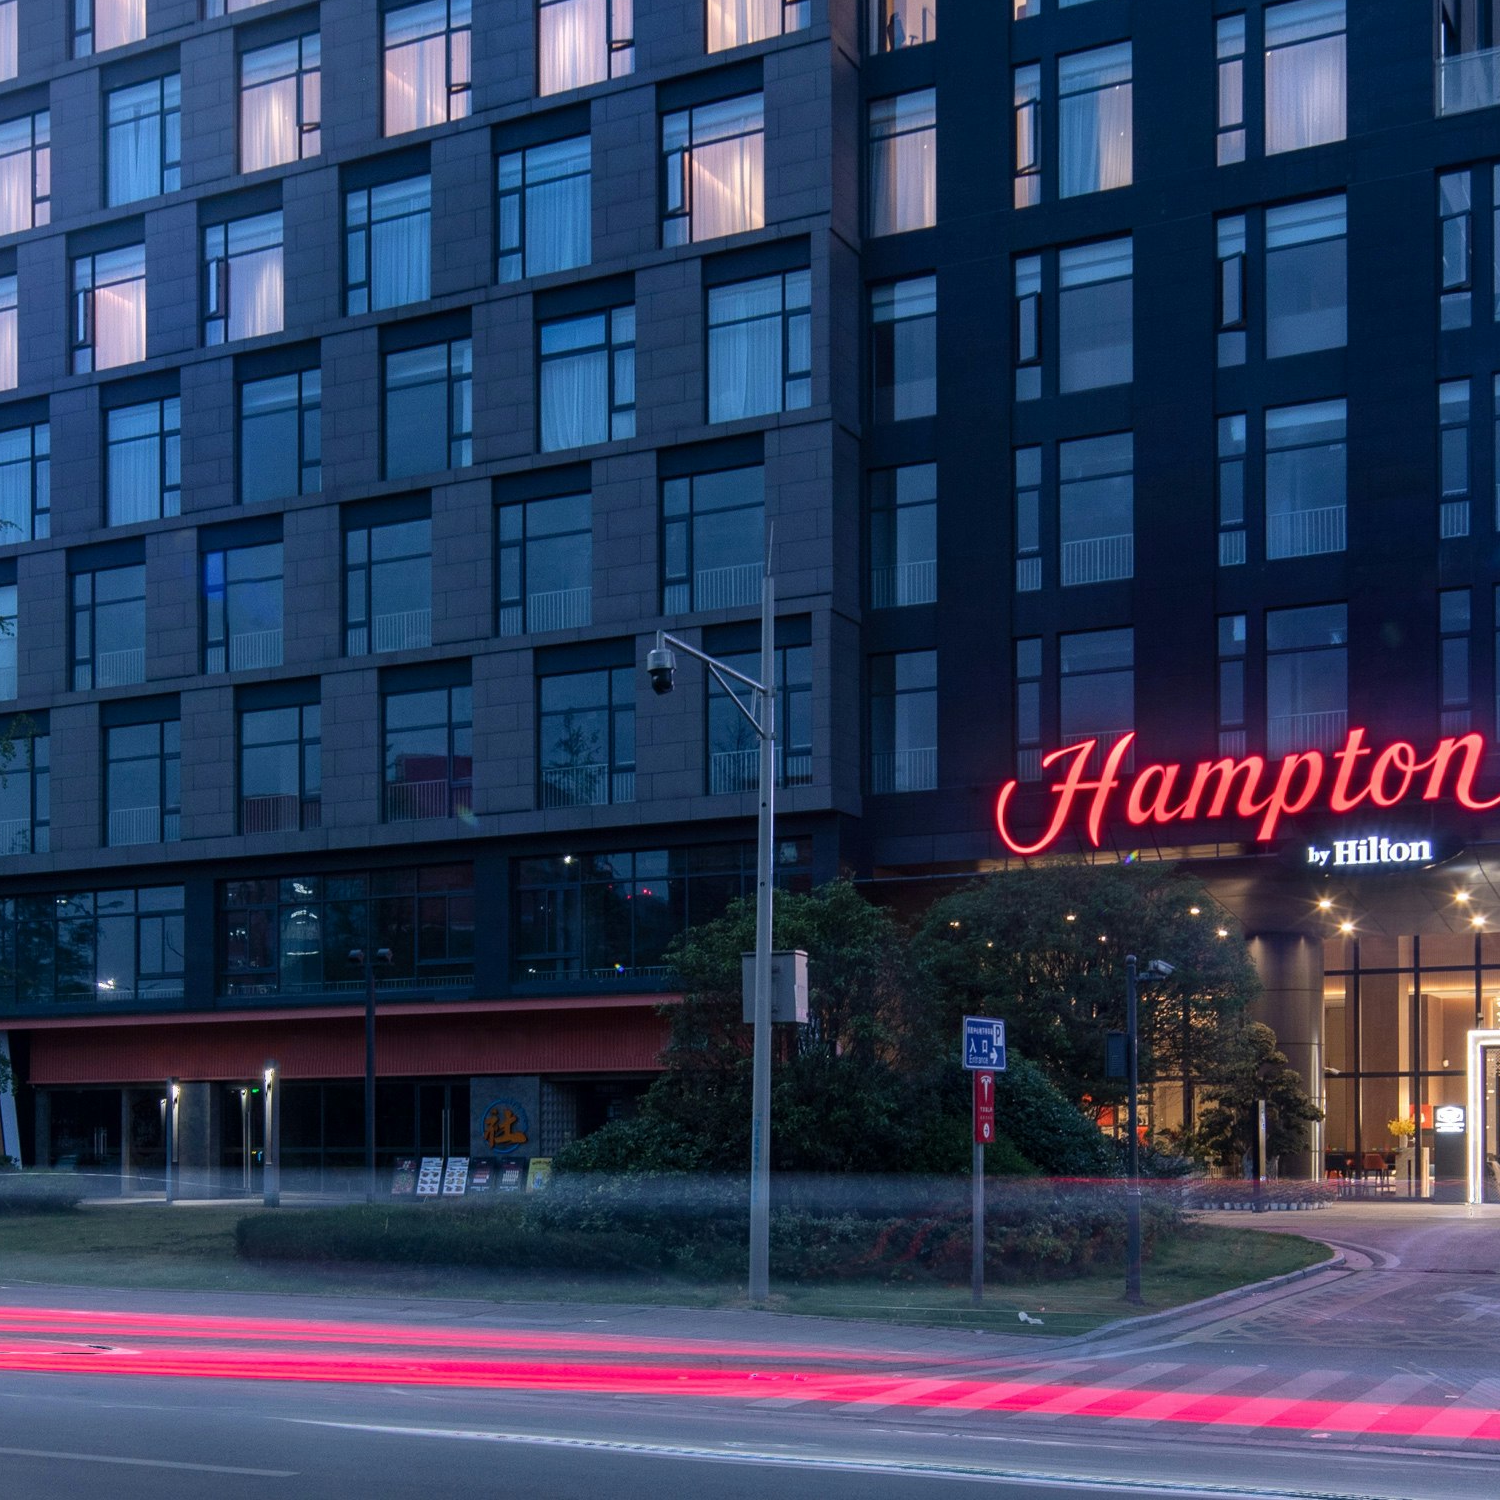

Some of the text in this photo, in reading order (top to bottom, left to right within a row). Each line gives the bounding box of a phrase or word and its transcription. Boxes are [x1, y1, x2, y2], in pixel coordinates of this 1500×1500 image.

[1307, 835, 1433, 867] by Hilton
[969, 1038, 988, 1053] 入口
[969, 1054, 989, 1064] Entrance
